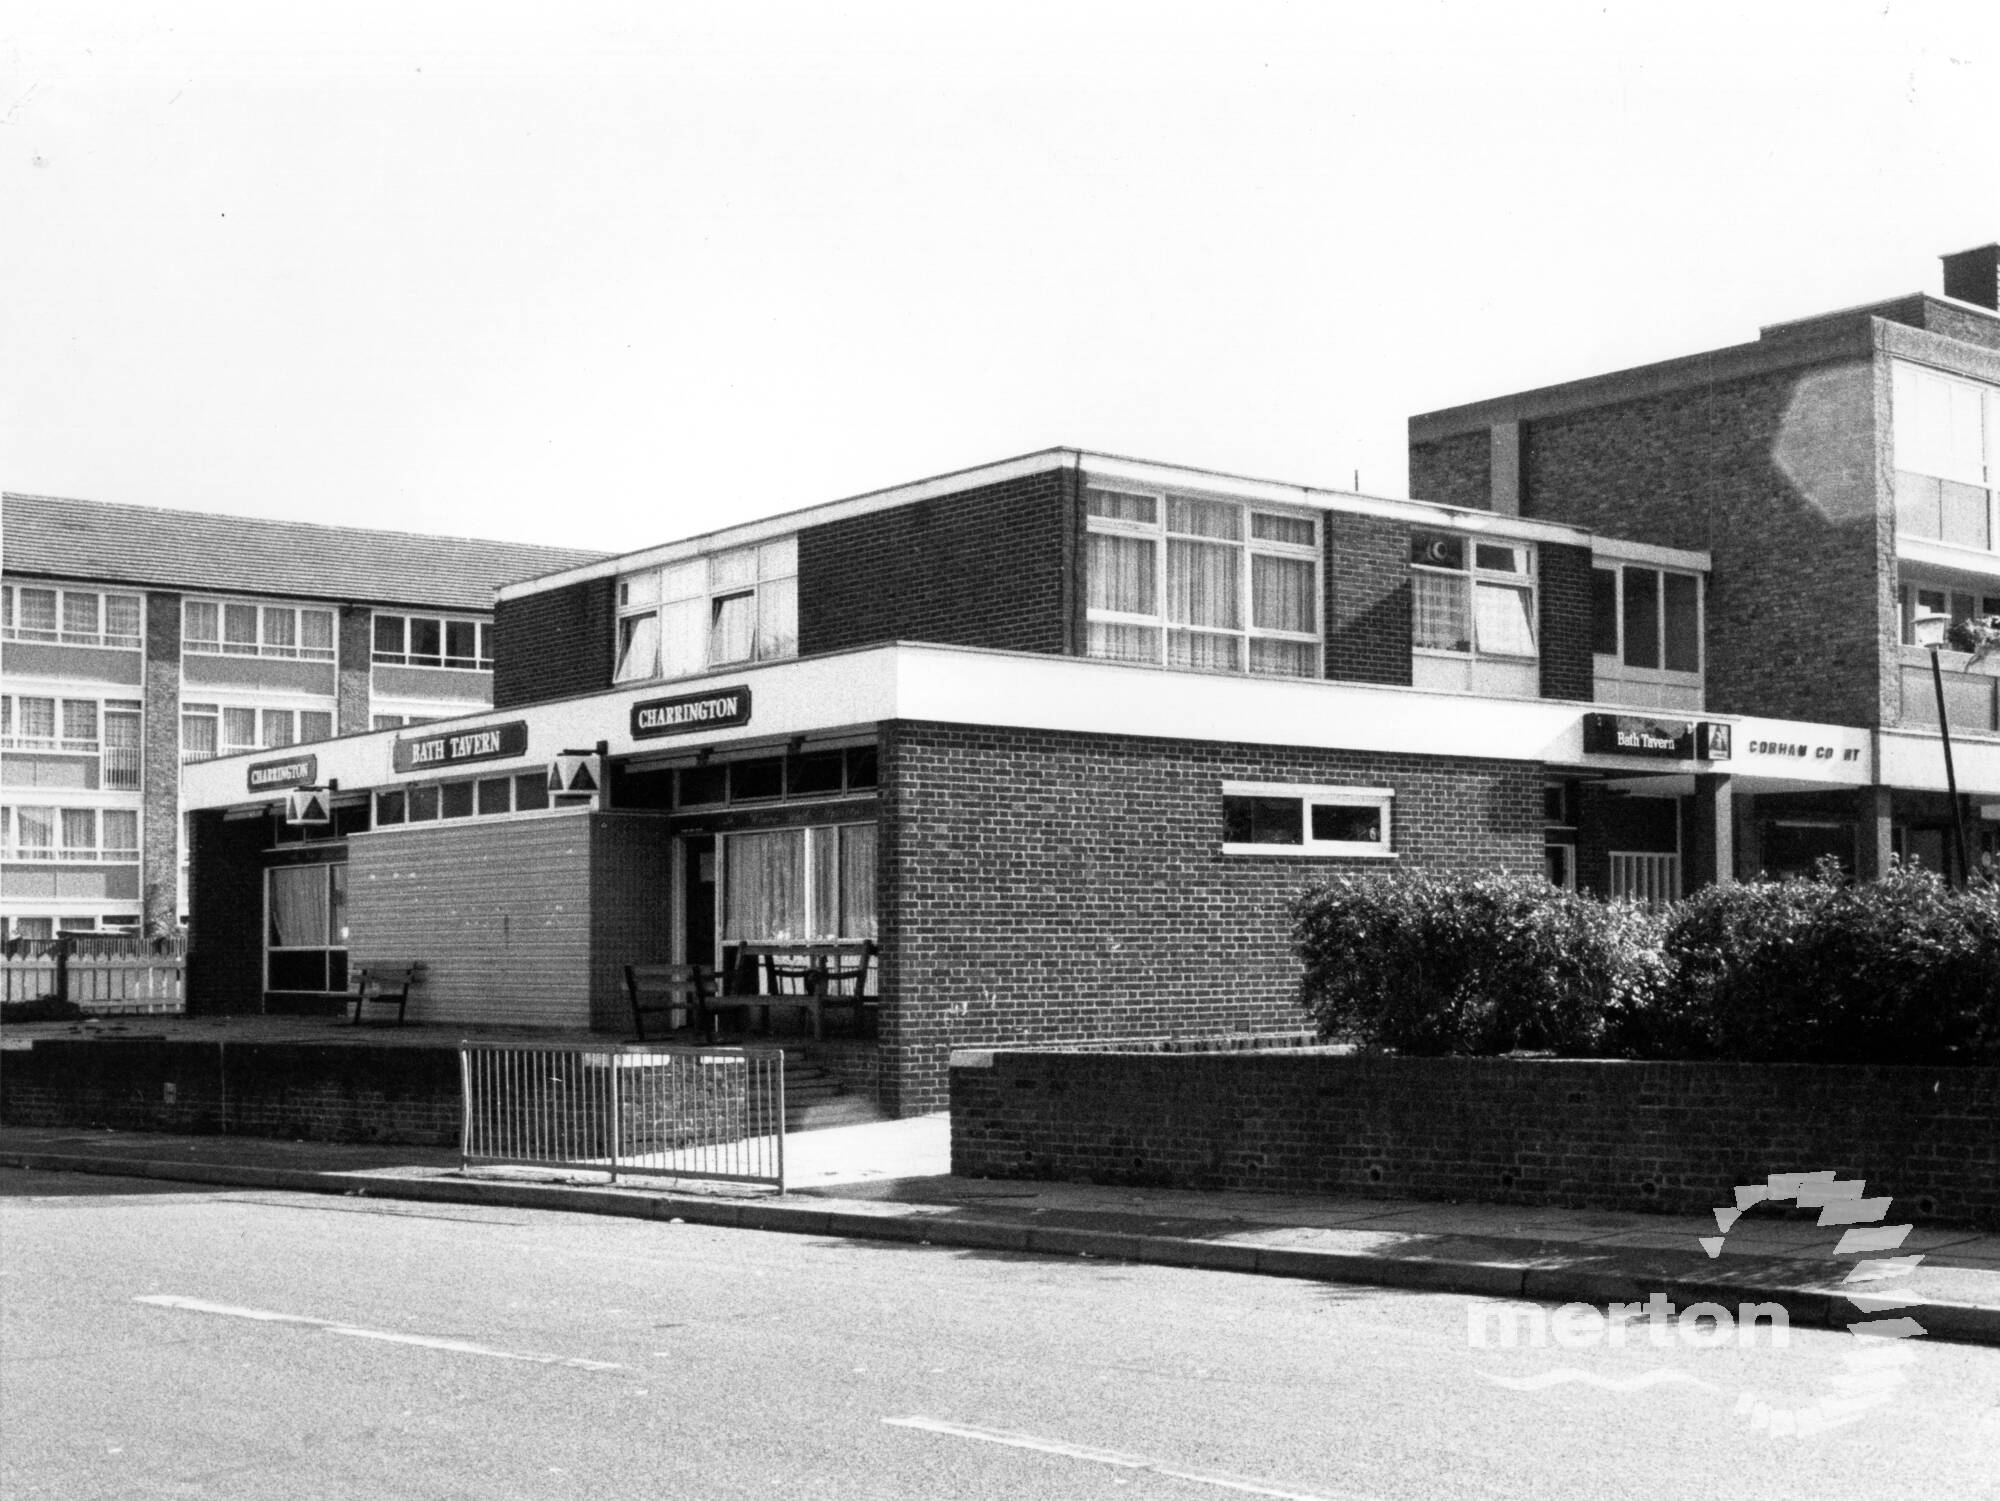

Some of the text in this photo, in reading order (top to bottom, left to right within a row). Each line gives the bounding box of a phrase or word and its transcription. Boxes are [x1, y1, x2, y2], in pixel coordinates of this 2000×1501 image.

[638, 696, 738, 729] CHARRINGTON
[412, 730, 501, 764] BATH TAVERN
[1617, 731, 1676, 750] Bath Tavern
[1748, 740, 1808, 757] COBHAM
[251, 762, 309, 785] CHARRINGTON
